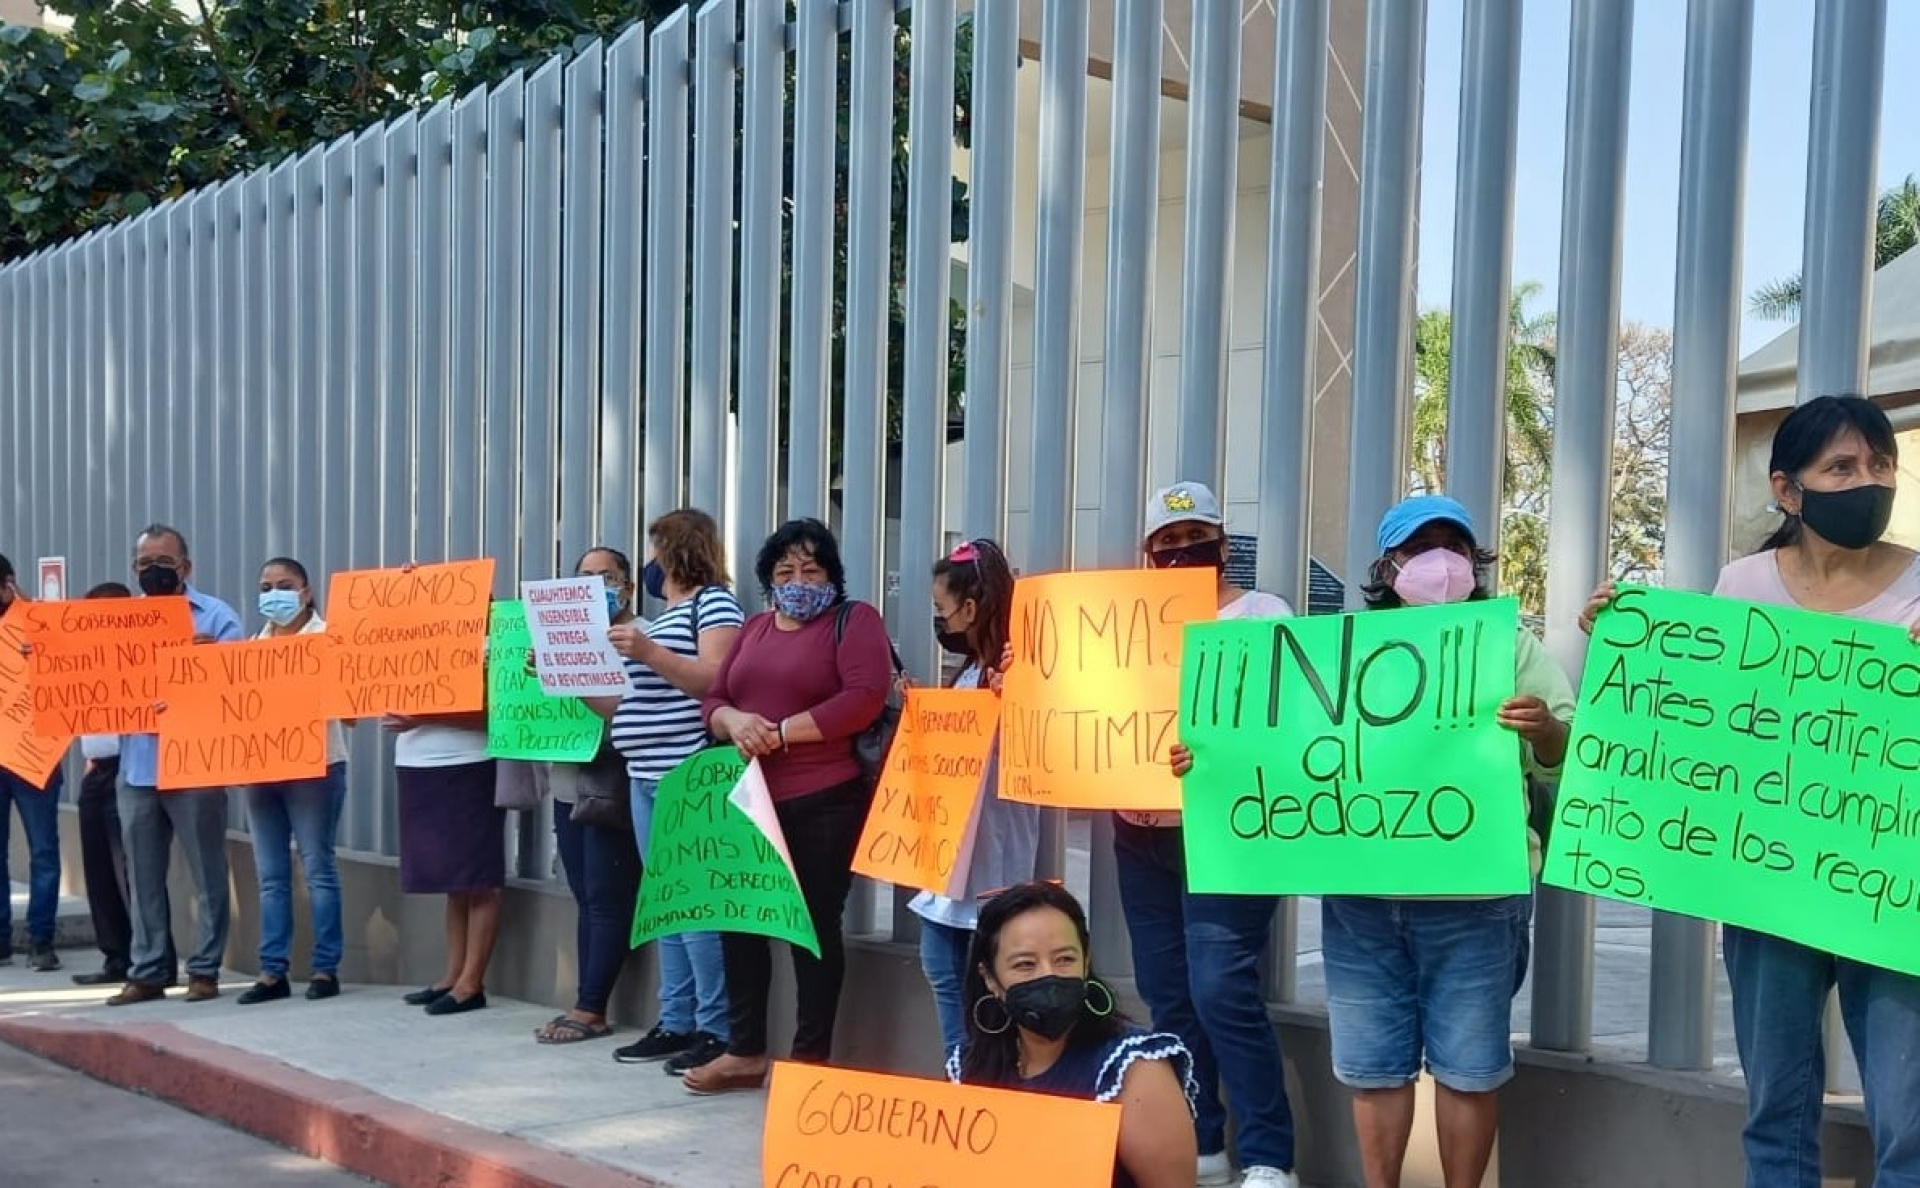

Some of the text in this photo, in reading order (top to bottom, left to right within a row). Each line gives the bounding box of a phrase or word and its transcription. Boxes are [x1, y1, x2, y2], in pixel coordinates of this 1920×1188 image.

[349, 566, 477, 610] EXIGIMOS
[528, 585, 593, 602] CUAUHTEMOC
[61, 604, 168, 633] GOBERNADOR
[353, 617, 451, 647] GOBERNADOR
[537, 608, 591, 623] INSENSIBLE
[546, 630, 590, 645] ENTREGA
[1021, 598, 1058, 680] NO
[114, 641, 146, 672] NO
[168, 656, 208, 685] LAS
[220, 641, 321, 685] VICTIMAS
[338, 648, 479, 685] REUNION CON
[542, 651, 606, 667] EL RECURSO Y
[33, 679, 109, 712] OLVIDO
[345, 674, 457, 715] VICTIMAS
[541, 673, 556, 687] NO
[1590, 653, 1715, 728] Antes
[1727, 688, 1781, 740] de
[221, 689, 263, 724] NO
[163, 719, 324, 777] OLVIDAMOS
[1303, 717, 1363, 784] al
[1575, 729, 1739, 795] analicen
[1753, 752, 1792, 806] el
[882, 787, 898, 813] Y
[1230, 765, 1475, 842] dedazo
[678, 834, 741, 866] MAS
[1560, 785, 1920, 924] ento de los requ
[724, 899, 746, 918] DE
[796, 1079, 998, 1155] GOBIERNO
